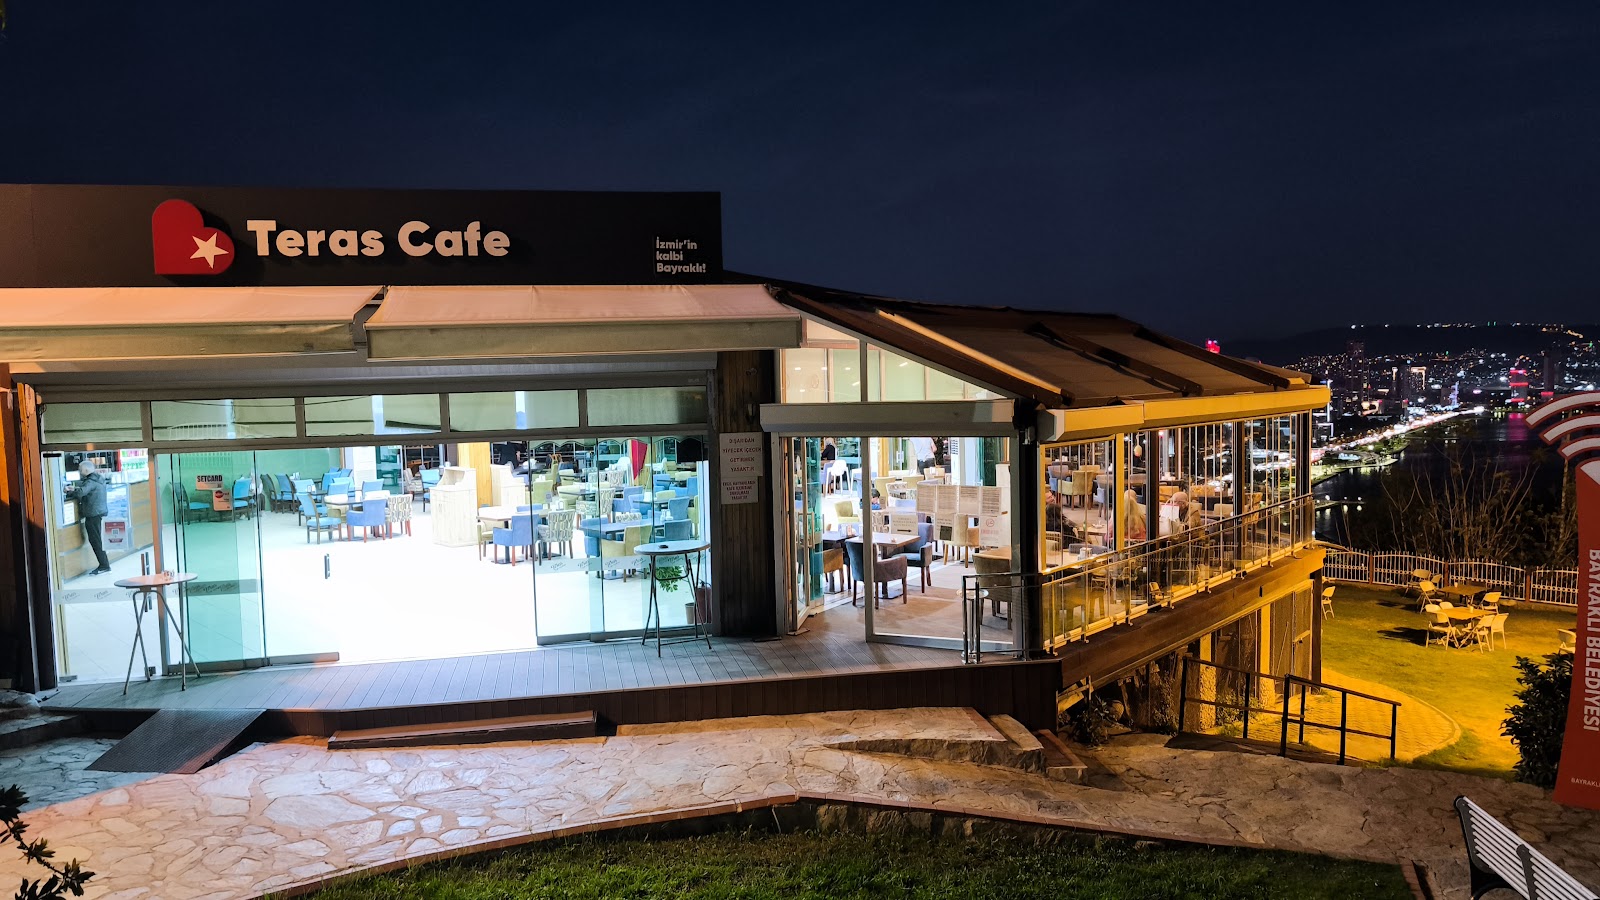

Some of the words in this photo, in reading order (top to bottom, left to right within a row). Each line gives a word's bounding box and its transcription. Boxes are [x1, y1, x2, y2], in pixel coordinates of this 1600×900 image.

[247, 219, 385, 257] Teras
[397, 220, 511, 257] Cafe
[656, 250, 684, 261] kalbi
[1587, 549, 1600, 632] BAYRAKLI
